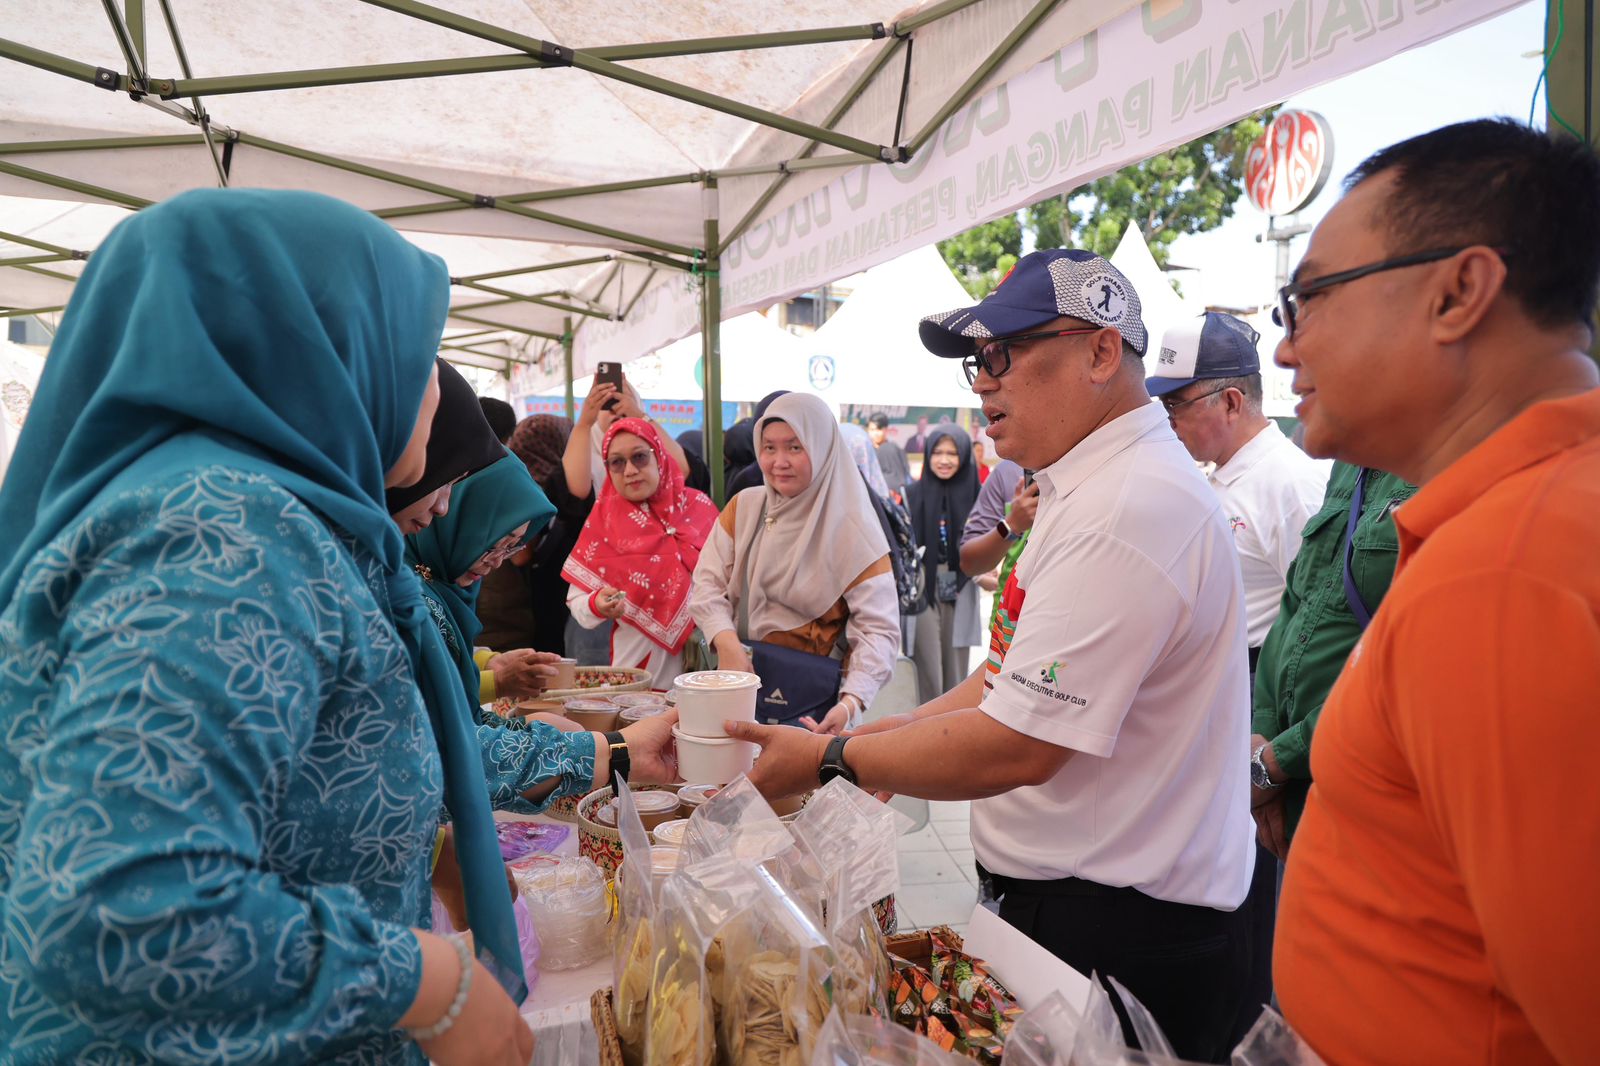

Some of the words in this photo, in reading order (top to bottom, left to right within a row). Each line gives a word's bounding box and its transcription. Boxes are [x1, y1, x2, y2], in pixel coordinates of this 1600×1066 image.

[1086, 275, 1102, 288] GOLF
[1103, 276, 1126, 302] CHARITY
[1085, 296, 1124, 322] TOURNAMENT
[1010, 672, 1027, 685] BATAM
[1026, 680, 1055, 698] EXECUTIVE
[1054, 691, 1070, 702] GOLF
[1070, 696, 1087, 707] CLUB
